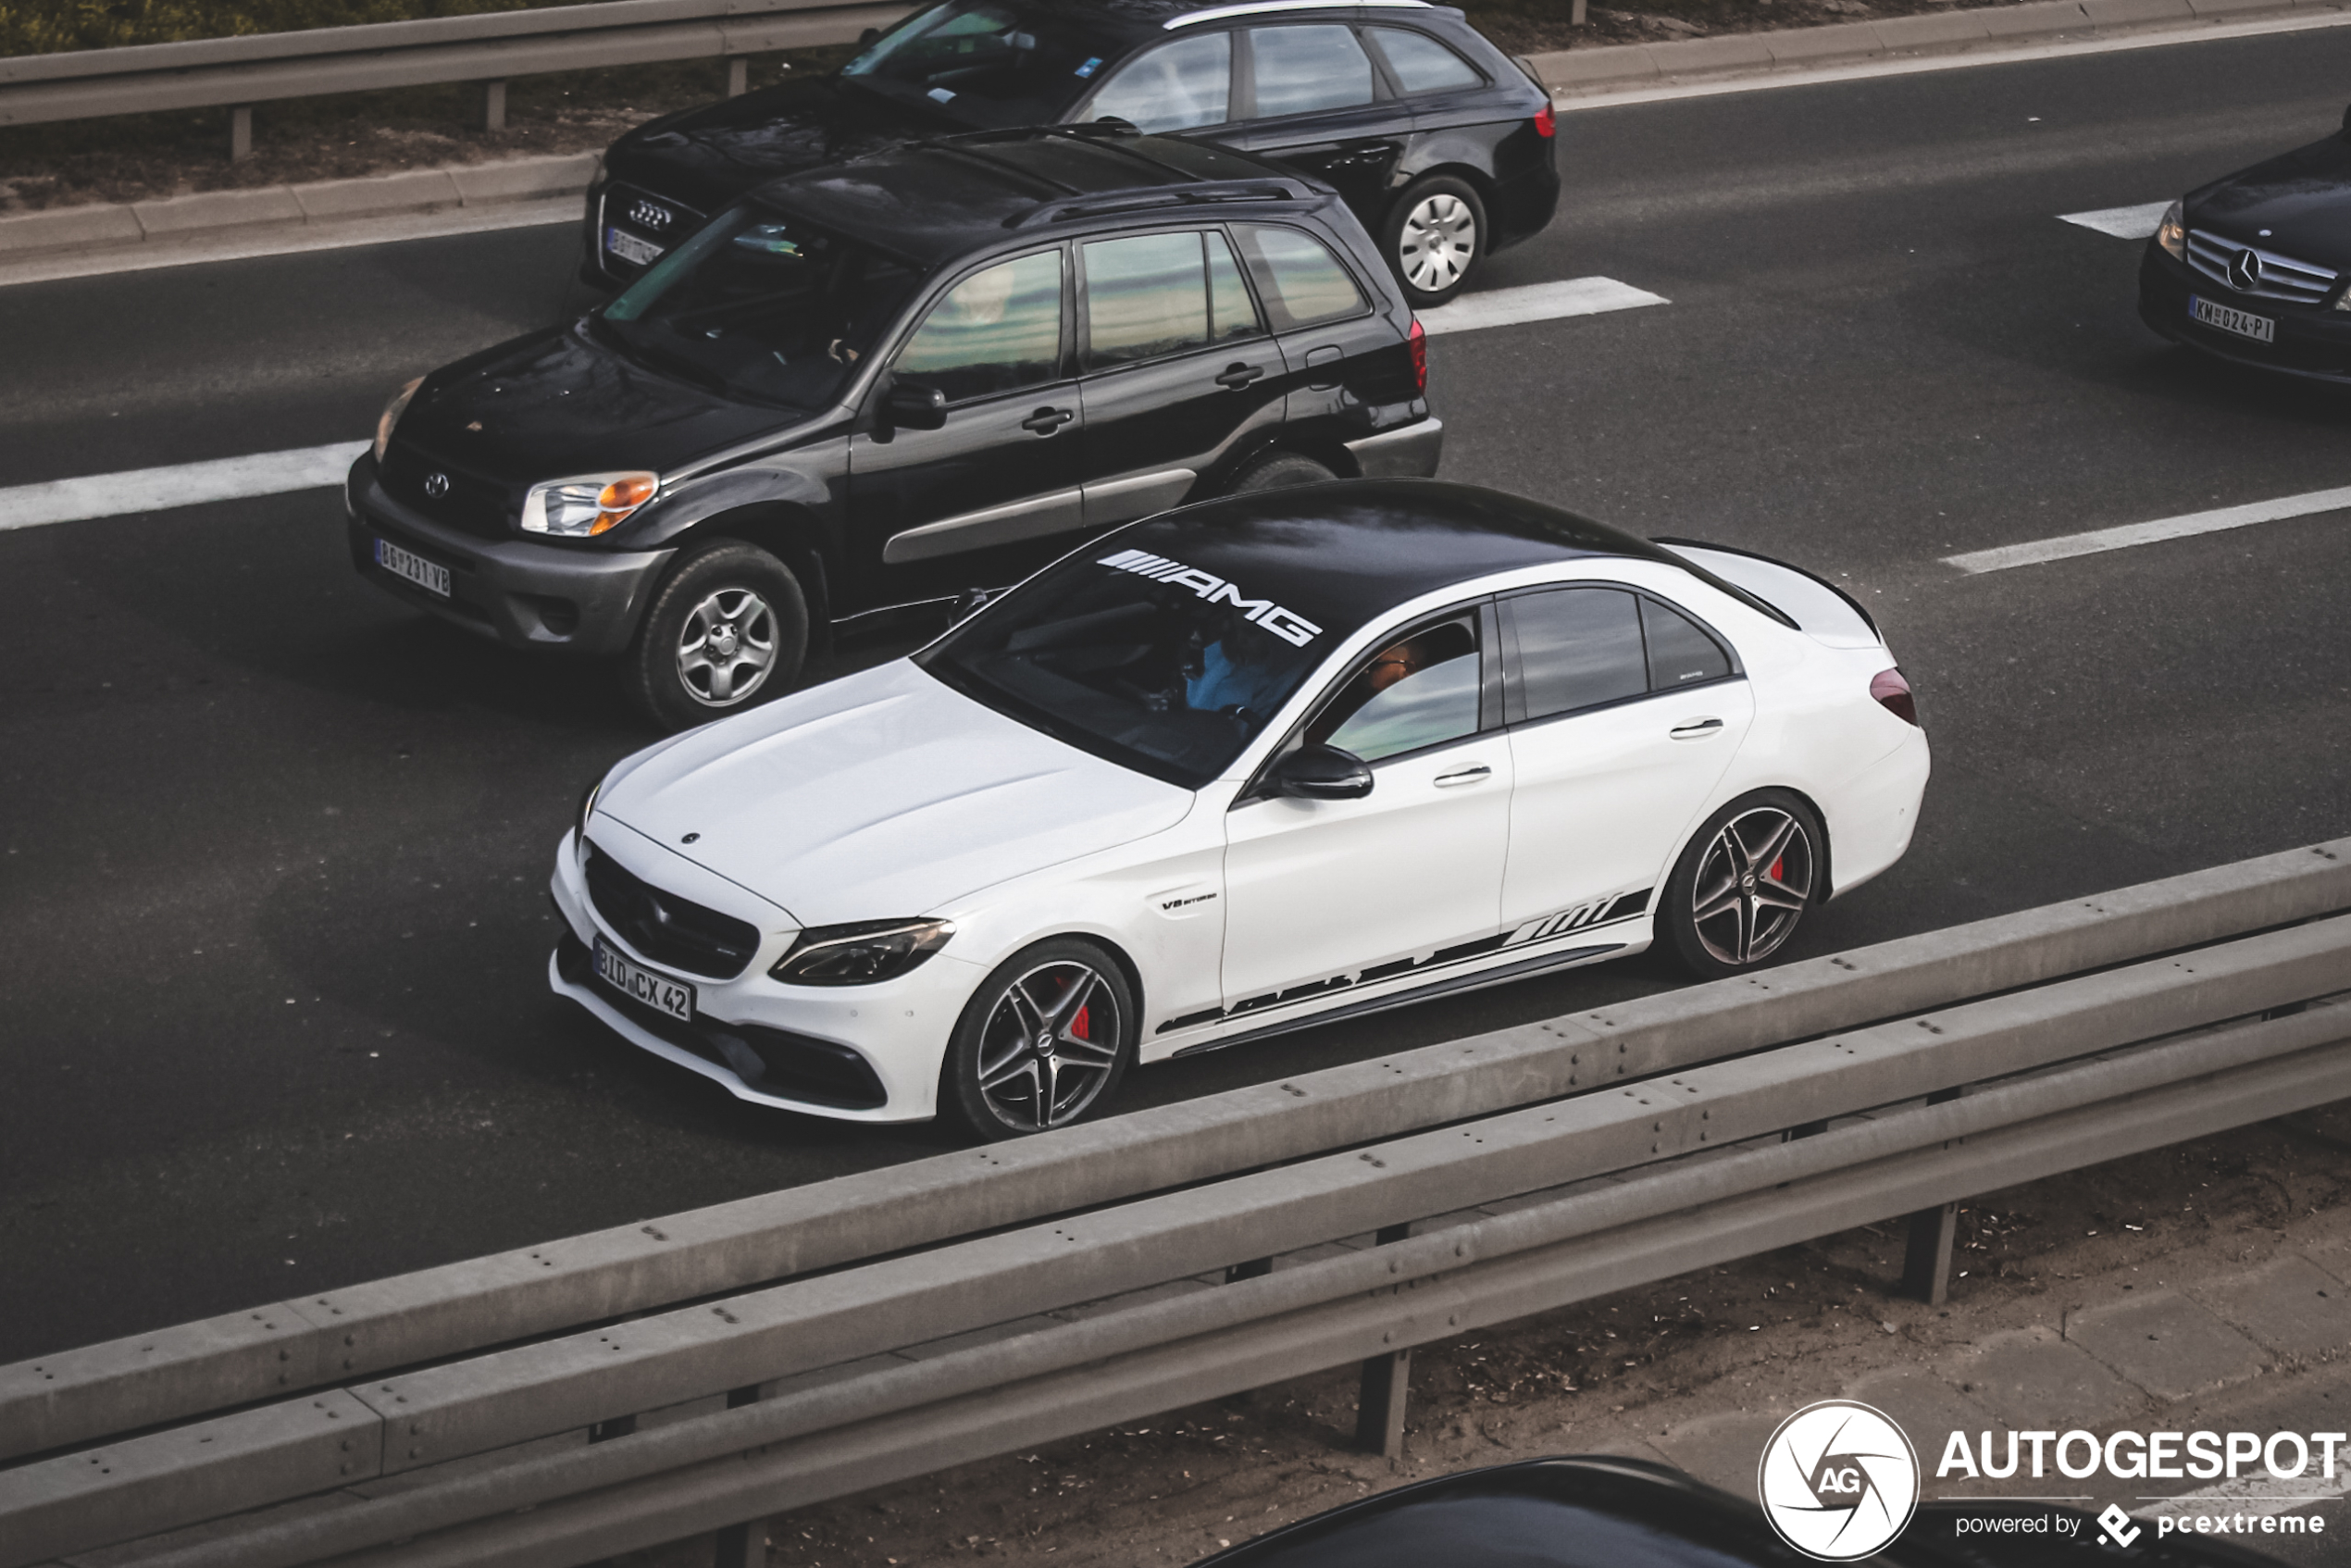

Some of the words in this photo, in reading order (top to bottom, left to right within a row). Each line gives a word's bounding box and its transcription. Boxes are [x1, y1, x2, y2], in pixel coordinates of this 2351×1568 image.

[2196, 300, 2213, 322] KM
[382, 542, 397, 568] BG
[1157, 568, 1324, 648] AMG
[1163, 899, 1182, 911] V8
[601, 947, 626, 988] BID
[636, 973, 658, 1005] CX
[663, 987, 687, 1017] 42
